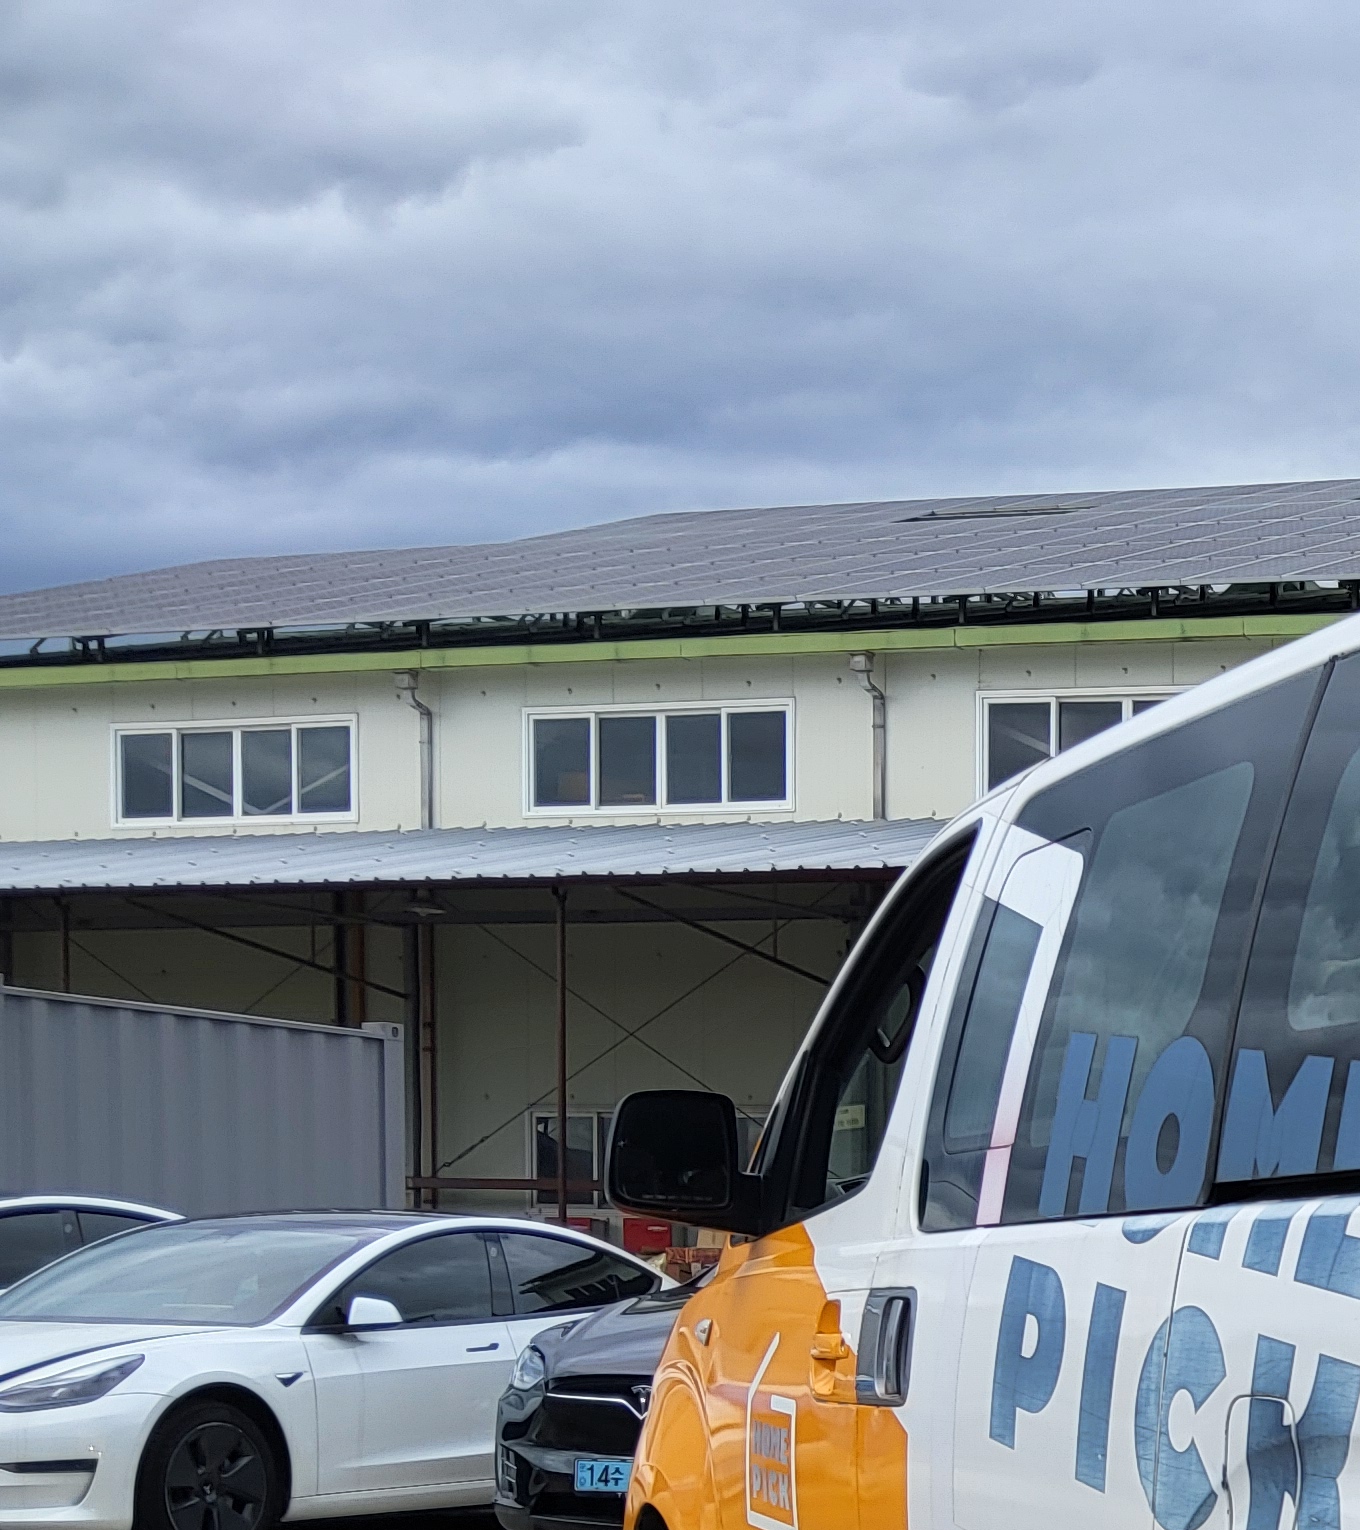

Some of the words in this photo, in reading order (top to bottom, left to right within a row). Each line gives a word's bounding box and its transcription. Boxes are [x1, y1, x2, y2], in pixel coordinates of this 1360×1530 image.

[753, 1420, 788, 1465] HOME
[586, 1463, 625, 1488] 14수
[752, 1464, 790, 1511] PICK
